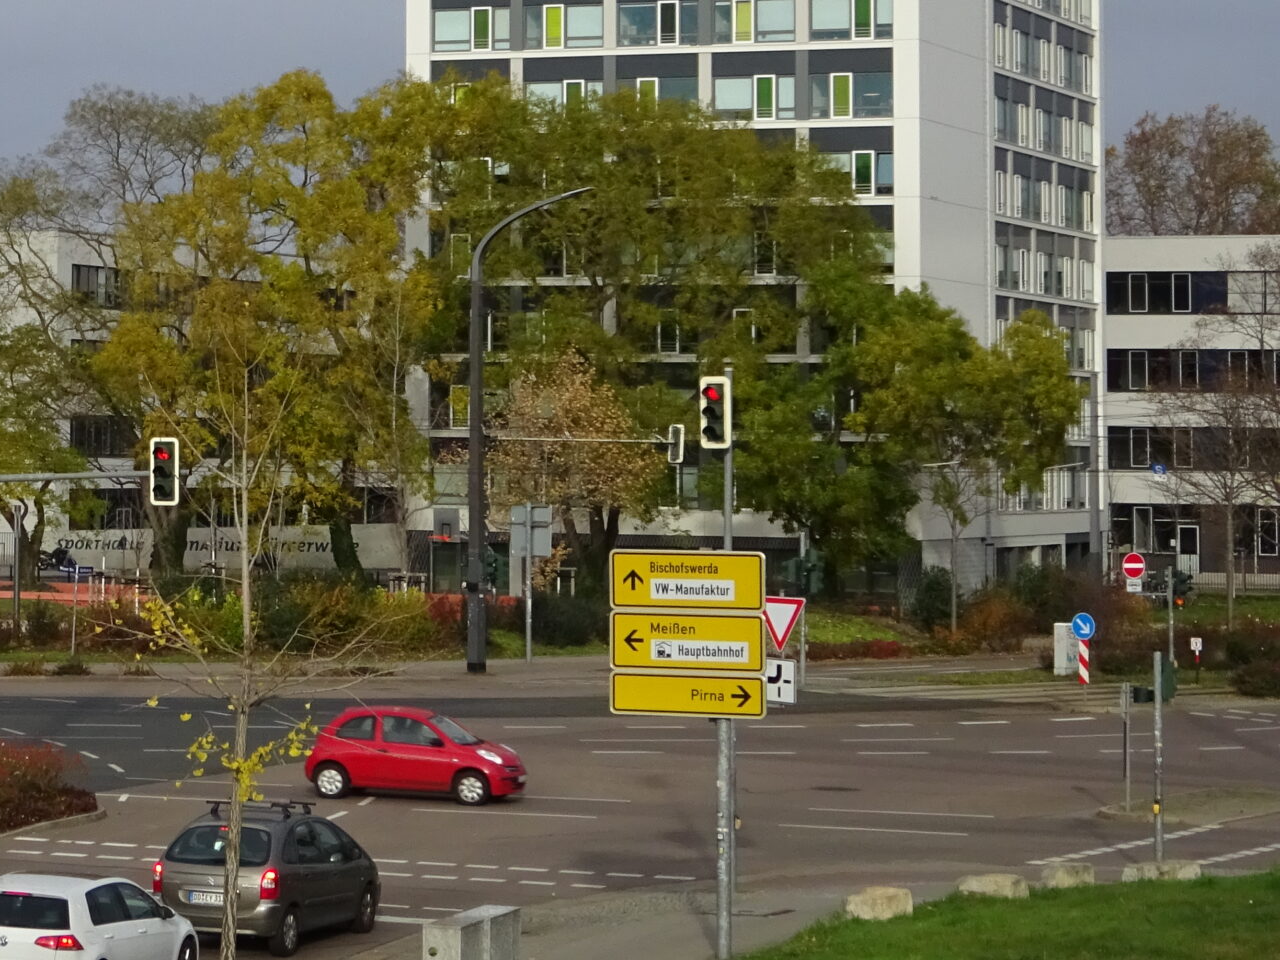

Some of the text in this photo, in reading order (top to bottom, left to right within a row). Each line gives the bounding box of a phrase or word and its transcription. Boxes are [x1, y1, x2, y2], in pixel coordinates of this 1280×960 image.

[650, 561, 719, 575] Bischofswerda
[654, 583, 731, 597] VW-Manufaktur
[650, 622, 696, 635] Meißen
[677, 644, 745, 659] Hauptbahnhof
[691, 689, 725, 702] Pirna
